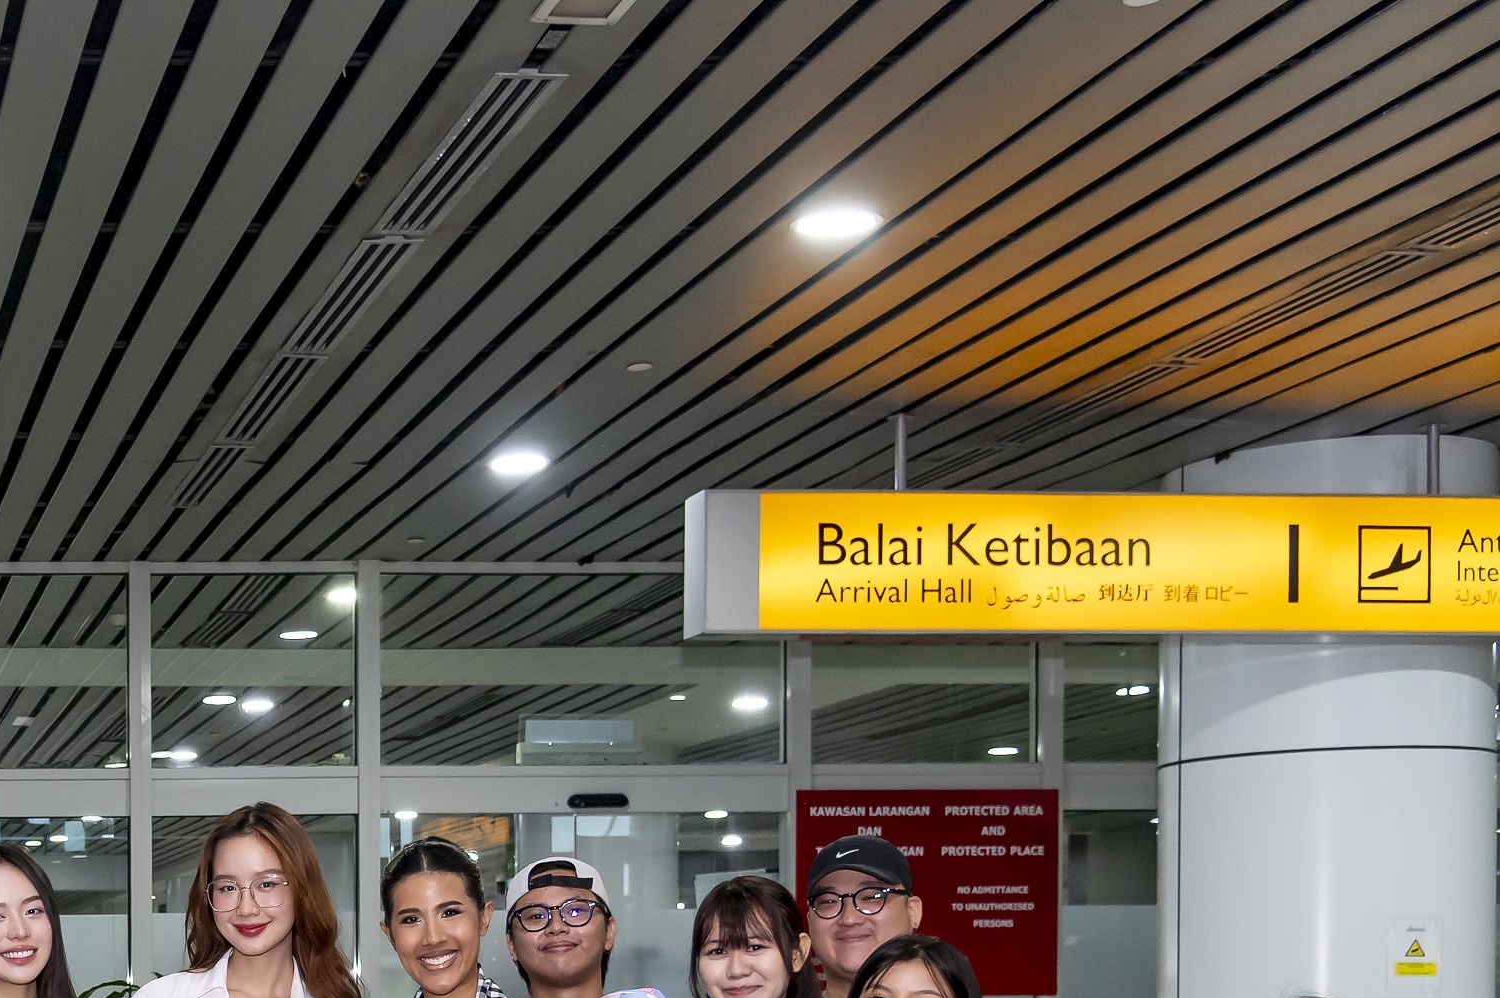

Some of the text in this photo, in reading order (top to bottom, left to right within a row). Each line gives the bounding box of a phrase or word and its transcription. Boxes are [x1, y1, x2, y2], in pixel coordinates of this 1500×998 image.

[818, 523, 1151, 566] Balai Ketibaan
[815, 578, 972, 604] Arrival Hall
[1098, 583, 1153, 602] 到达厅
[810, 806, 930, 817] KAWASAN LARANGAN
[944, 805, 1043, 816] PROTECTED AREA
[857, 826, 882, 837] DAN
[981, 826, 1006, 836] AND
[941, 846, 1045, 857] PROTECTED PLACE
[957, 886, 1029, 895] NO ADMITTANCE
[952, 902, 1035, 911] TO UNAUTHORISED
[973, 919, 1014, 928] PERSONS
